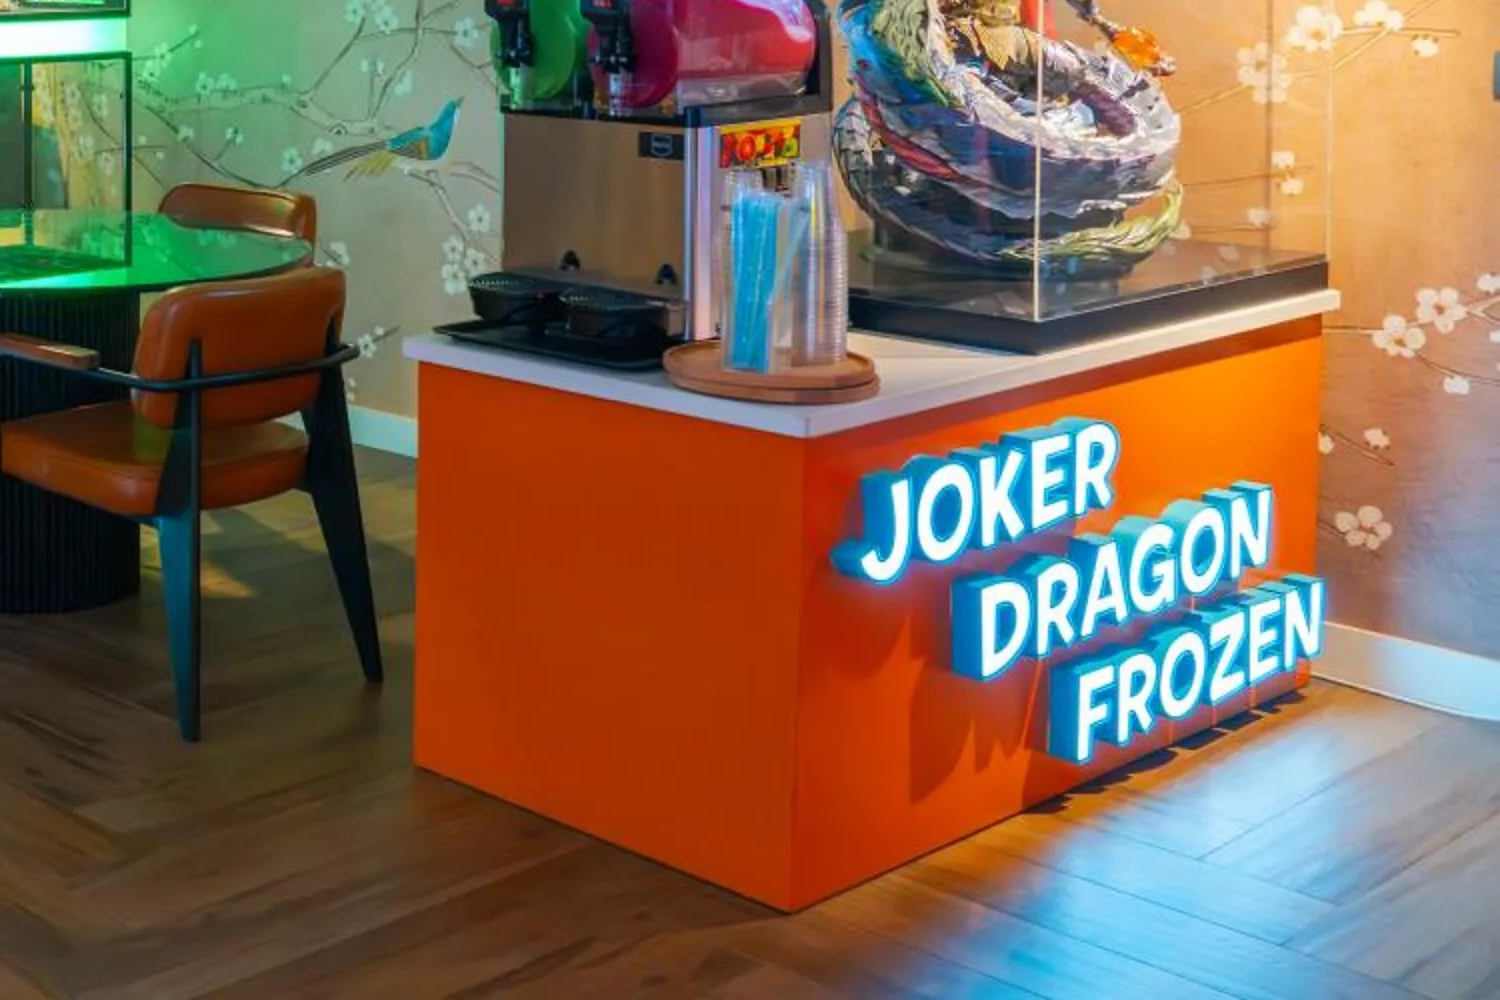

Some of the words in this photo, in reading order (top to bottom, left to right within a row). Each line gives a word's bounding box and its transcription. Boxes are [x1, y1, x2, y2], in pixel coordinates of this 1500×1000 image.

[858, 420, 1119, 582] JOKER
[979, 487, 1273, 679] DRAGON
[1076, 579, 1323, 762] FROZEN
